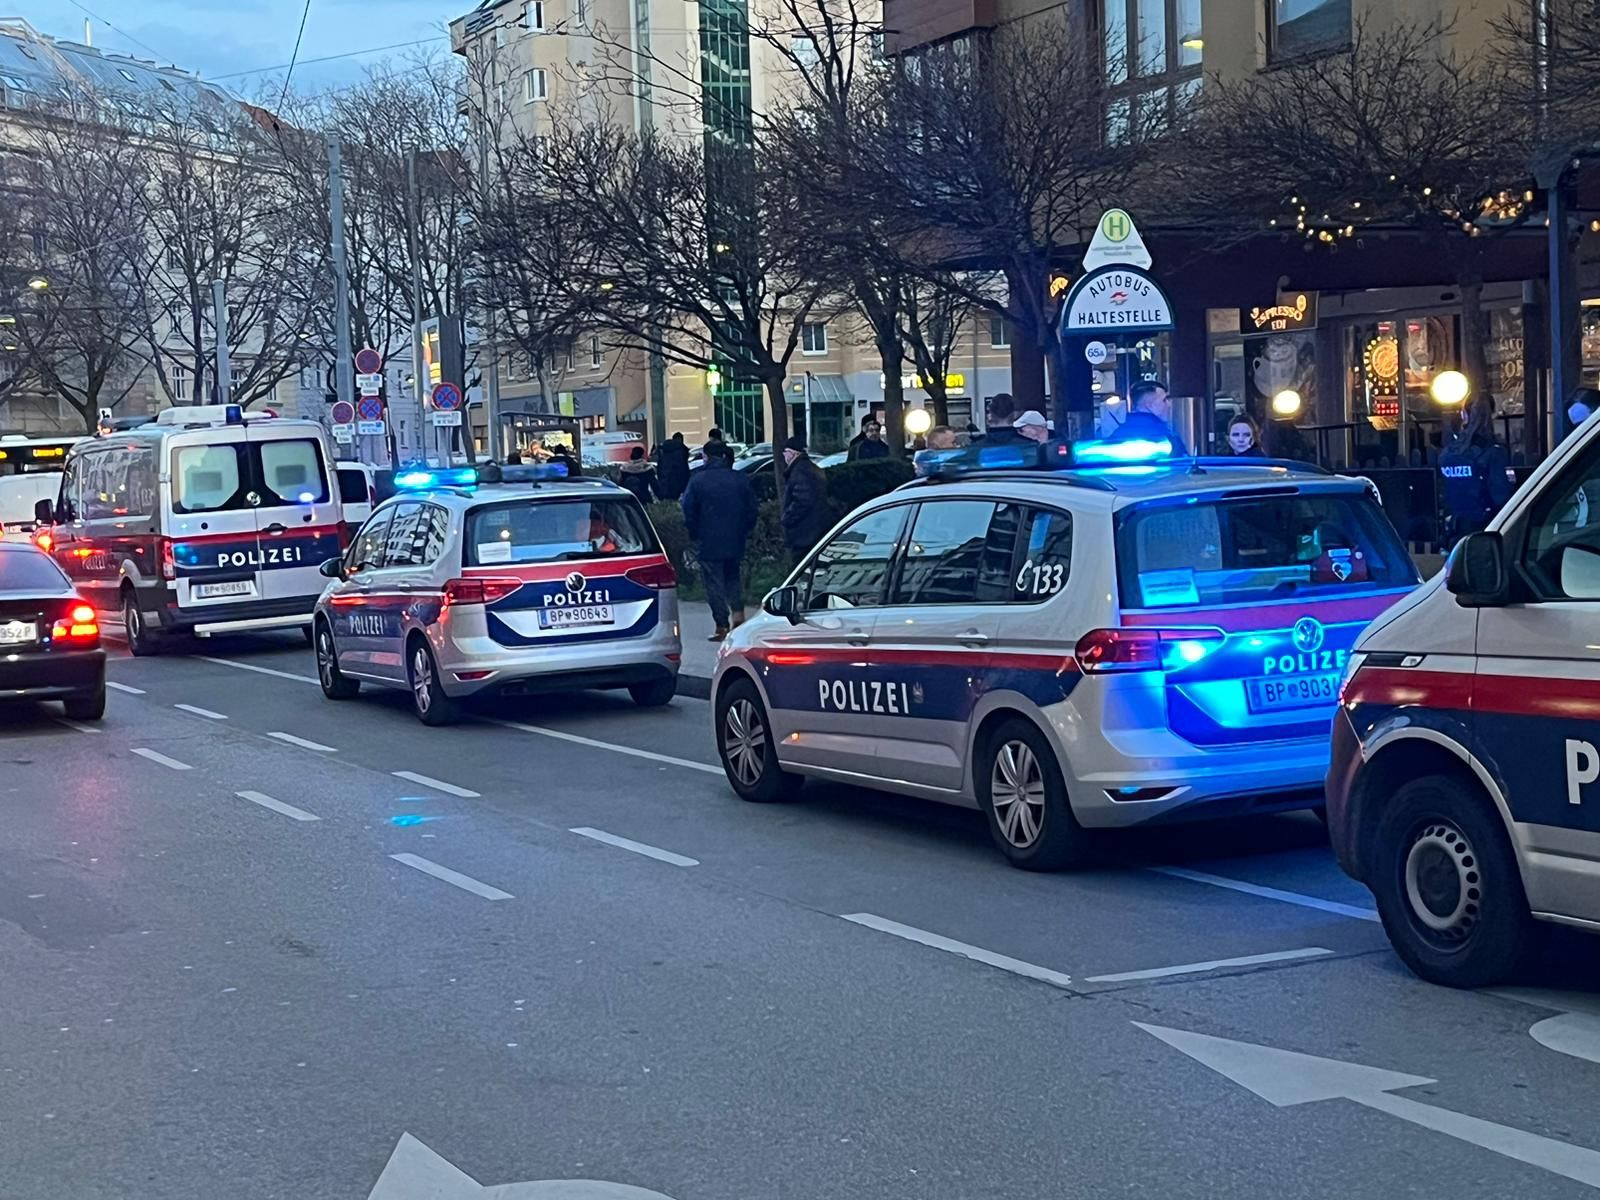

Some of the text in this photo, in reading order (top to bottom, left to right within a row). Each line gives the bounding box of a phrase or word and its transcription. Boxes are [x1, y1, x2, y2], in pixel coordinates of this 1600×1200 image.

[1109, 217, 1124, 237] H
[1089, 274, 1151, 298] AUTOBUS
[1078, 309, 1162, 326] HALTESTELLE
[1254, 305, 1303, 329] ESPRESSO
[1271, 319, 1287, 330] EDI
[218, 546, 301, 568] POLIZEI
[1033, 564, 1064, 594] 133
[543, 589, 610, 607] POLIZEI
[349, 615, 384, 635] POLIZEI
[818, 679, 910, 714] POLIZEI
